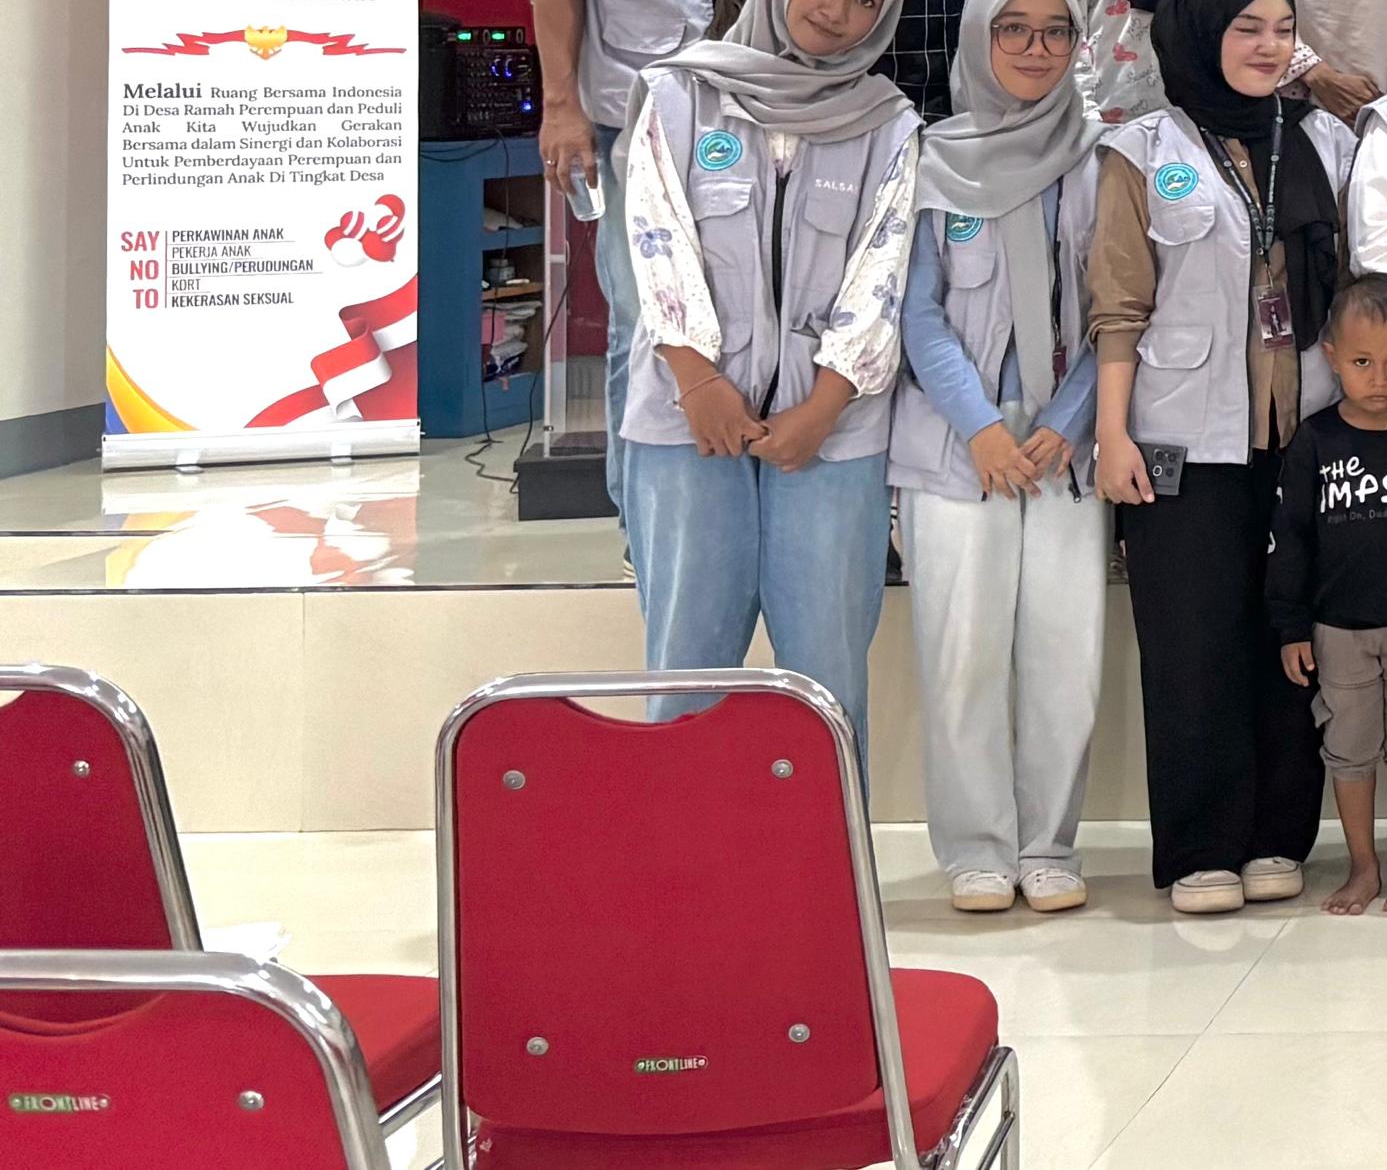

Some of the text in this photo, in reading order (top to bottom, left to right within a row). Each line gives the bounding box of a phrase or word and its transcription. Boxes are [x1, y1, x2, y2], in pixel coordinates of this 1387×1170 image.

[123, 82, 402, 101] Melalui Ruang Bersama Indonesia
[123, 102, 402, 119] Di Desa Ramah Perempuan dan Peduli
[122, 119, 402, 135] Anak Kita Wujudkan Gerakan
[122, 135, 402, 152] Bersama dalam Sinergi dan Kolaborasi
[122, 153, 402, 169] Untuk Pemberdayaan Perempuan dan
[122, 170, 385, 188] Perlindungan Anak Di Tingkat Desa
[120, 231, 160, 252] SAY
[172, 228, 284, 242] PERKAWINAN ANAK
[172, 245, 251, 258] PEKERJA ANAK
[130, 260, 159, 280] NO
[172, 259, 314, 275] BULLYING/PERUDUNGAN
[172, 279, 201, 291] KDRT
[133, 289, 159, 309] TO
[172, 292, 294, 308] KEKERASAN SEKSUAL
